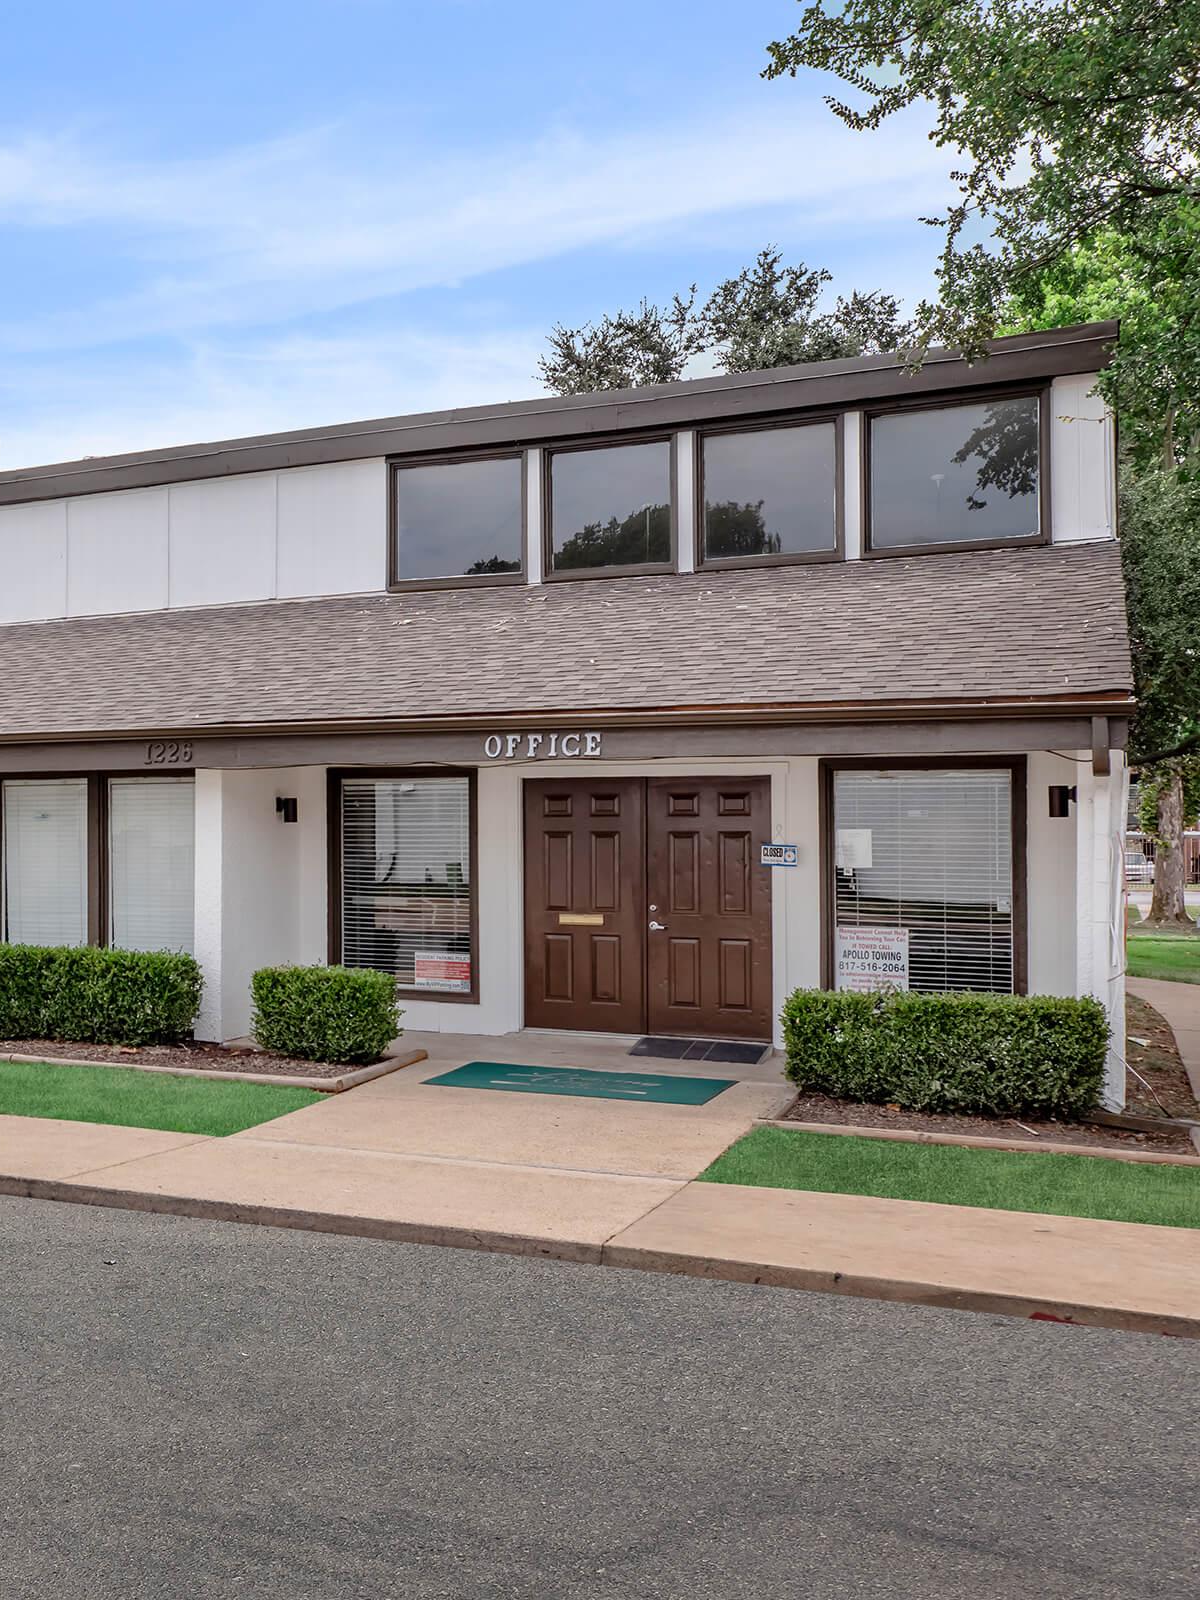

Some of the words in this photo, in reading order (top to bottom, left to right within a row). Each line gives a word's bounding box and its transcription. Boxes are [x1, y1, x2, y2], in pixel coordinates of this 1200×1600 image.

[484, 733, 601, 758] OFFICE
[763, 847, 783, 857] CLOSED
[843, 950, 870, 960] APOLLO
[872, 951, 901, 961] TOWING
[839, 961, 905, 973] 817-516-2064
